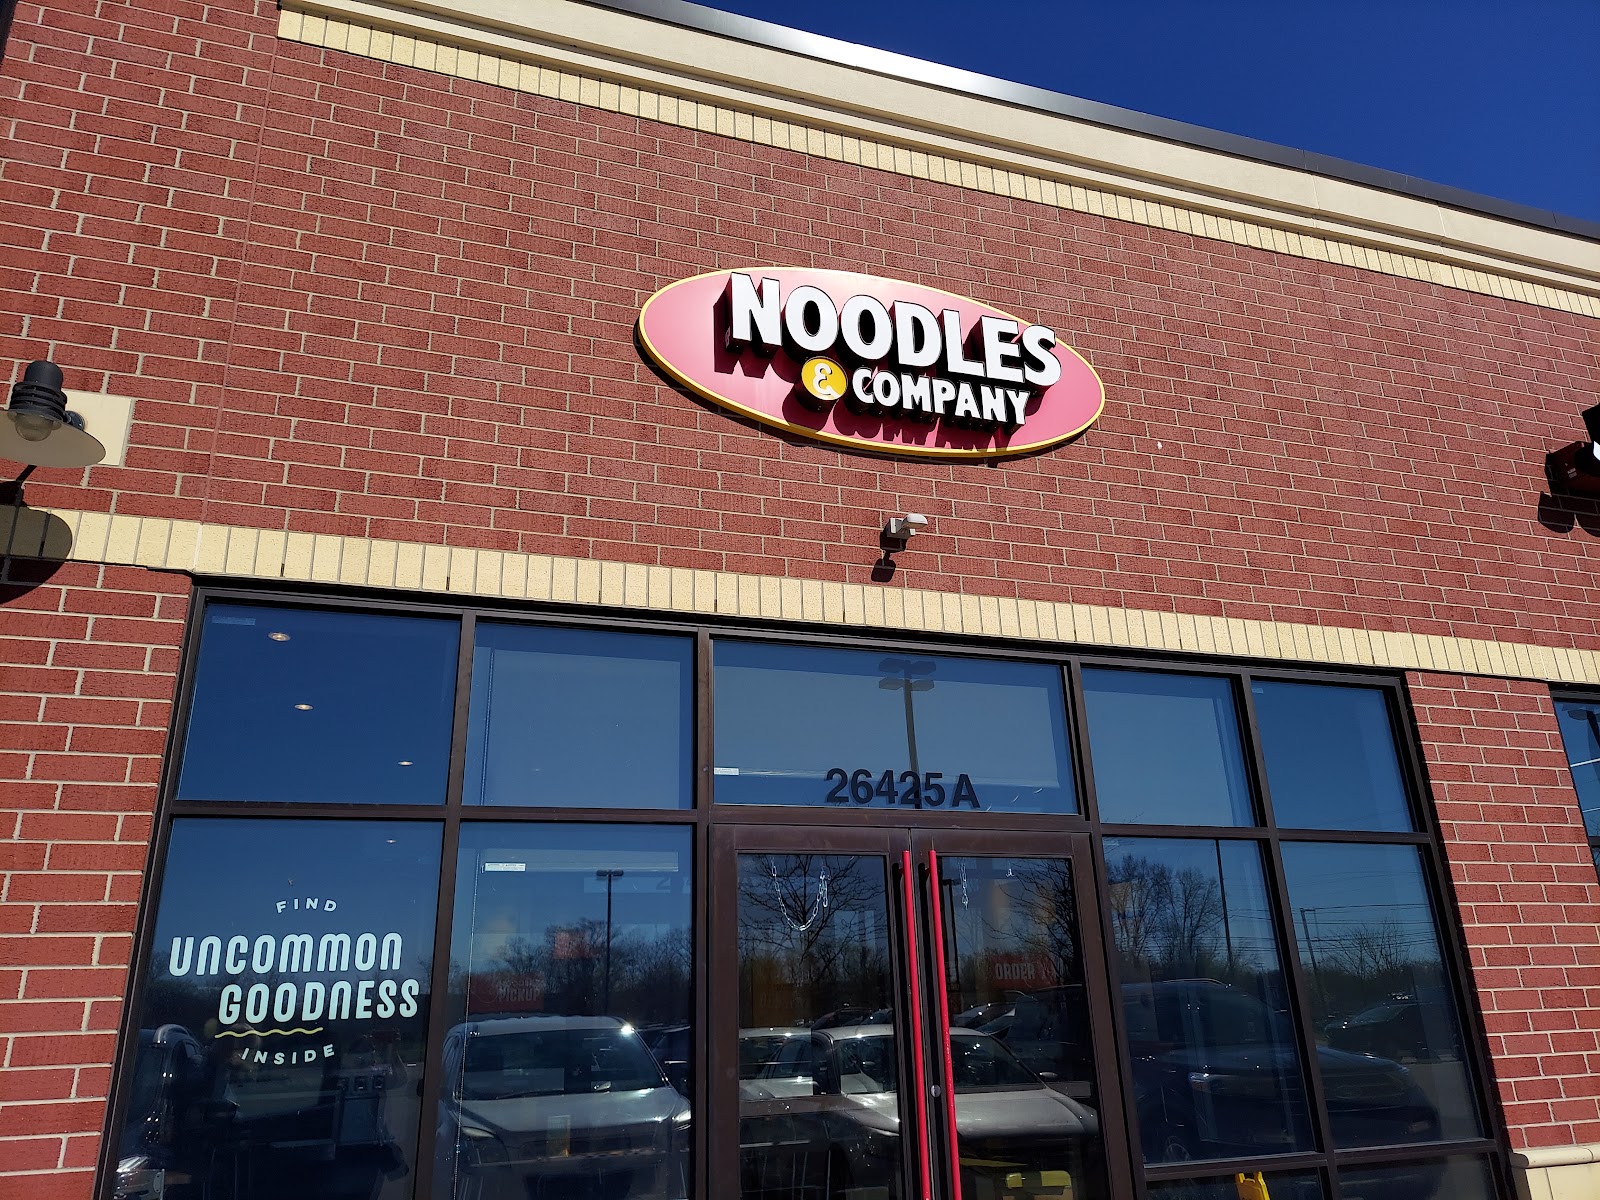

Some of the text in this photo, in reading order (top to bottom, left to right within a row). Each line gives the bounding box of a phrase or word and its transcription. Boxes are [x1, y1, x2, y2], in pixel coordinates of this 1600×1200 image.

[730, 272, 1062, 387] NOODLES
[812, 361, 1030, 425] & COMPANY
[275, 897, 338, 914] FIND
[994, 962, 1036, 980] ORDER
[218, 978, 420, 1025] GOODNESS
[497, 986, 541, 1003] PICKUP
[241, 1043, 335, 1066] INSIDE
